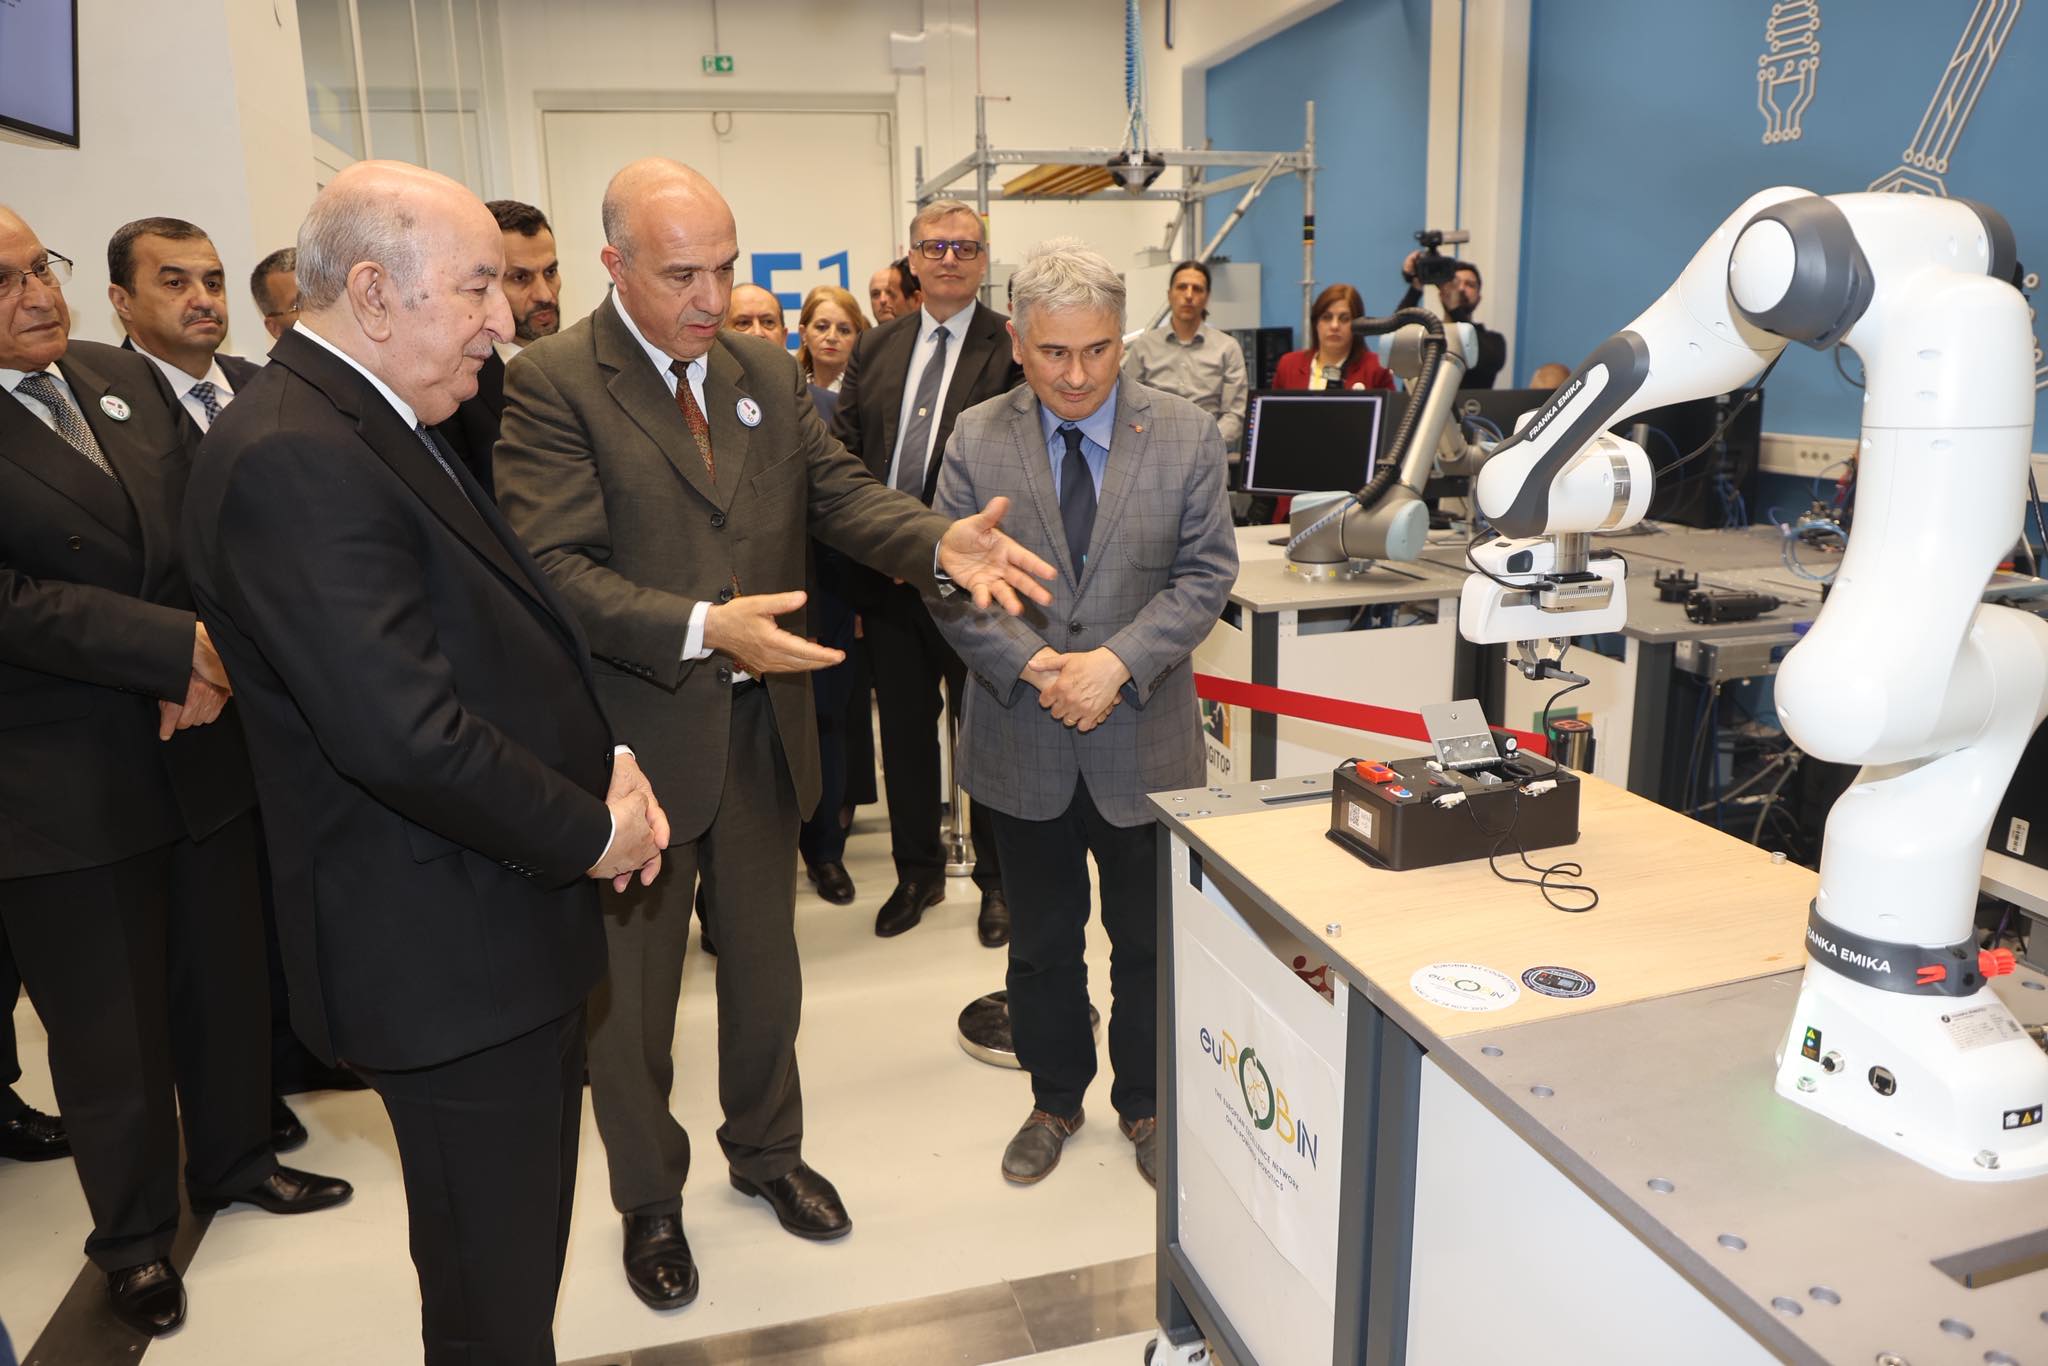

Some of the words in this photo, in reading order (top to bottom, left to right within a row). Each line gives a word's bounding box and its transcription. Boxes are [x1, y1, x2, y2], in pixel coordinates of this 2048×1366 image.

[1529, 405, 1558, 439] FRANKA
[1557, 379, 1582, 407] EMIKA
[1205, 742, 1231, 776] IGITOP
[1806, 926, 1838, 957] RANKA
[1840, 947, 1892, 974] EMIKA
[1200, 1027, 1318, 1172] euROBIN
[1272, 1160, 1300, 1192] NETWORK
